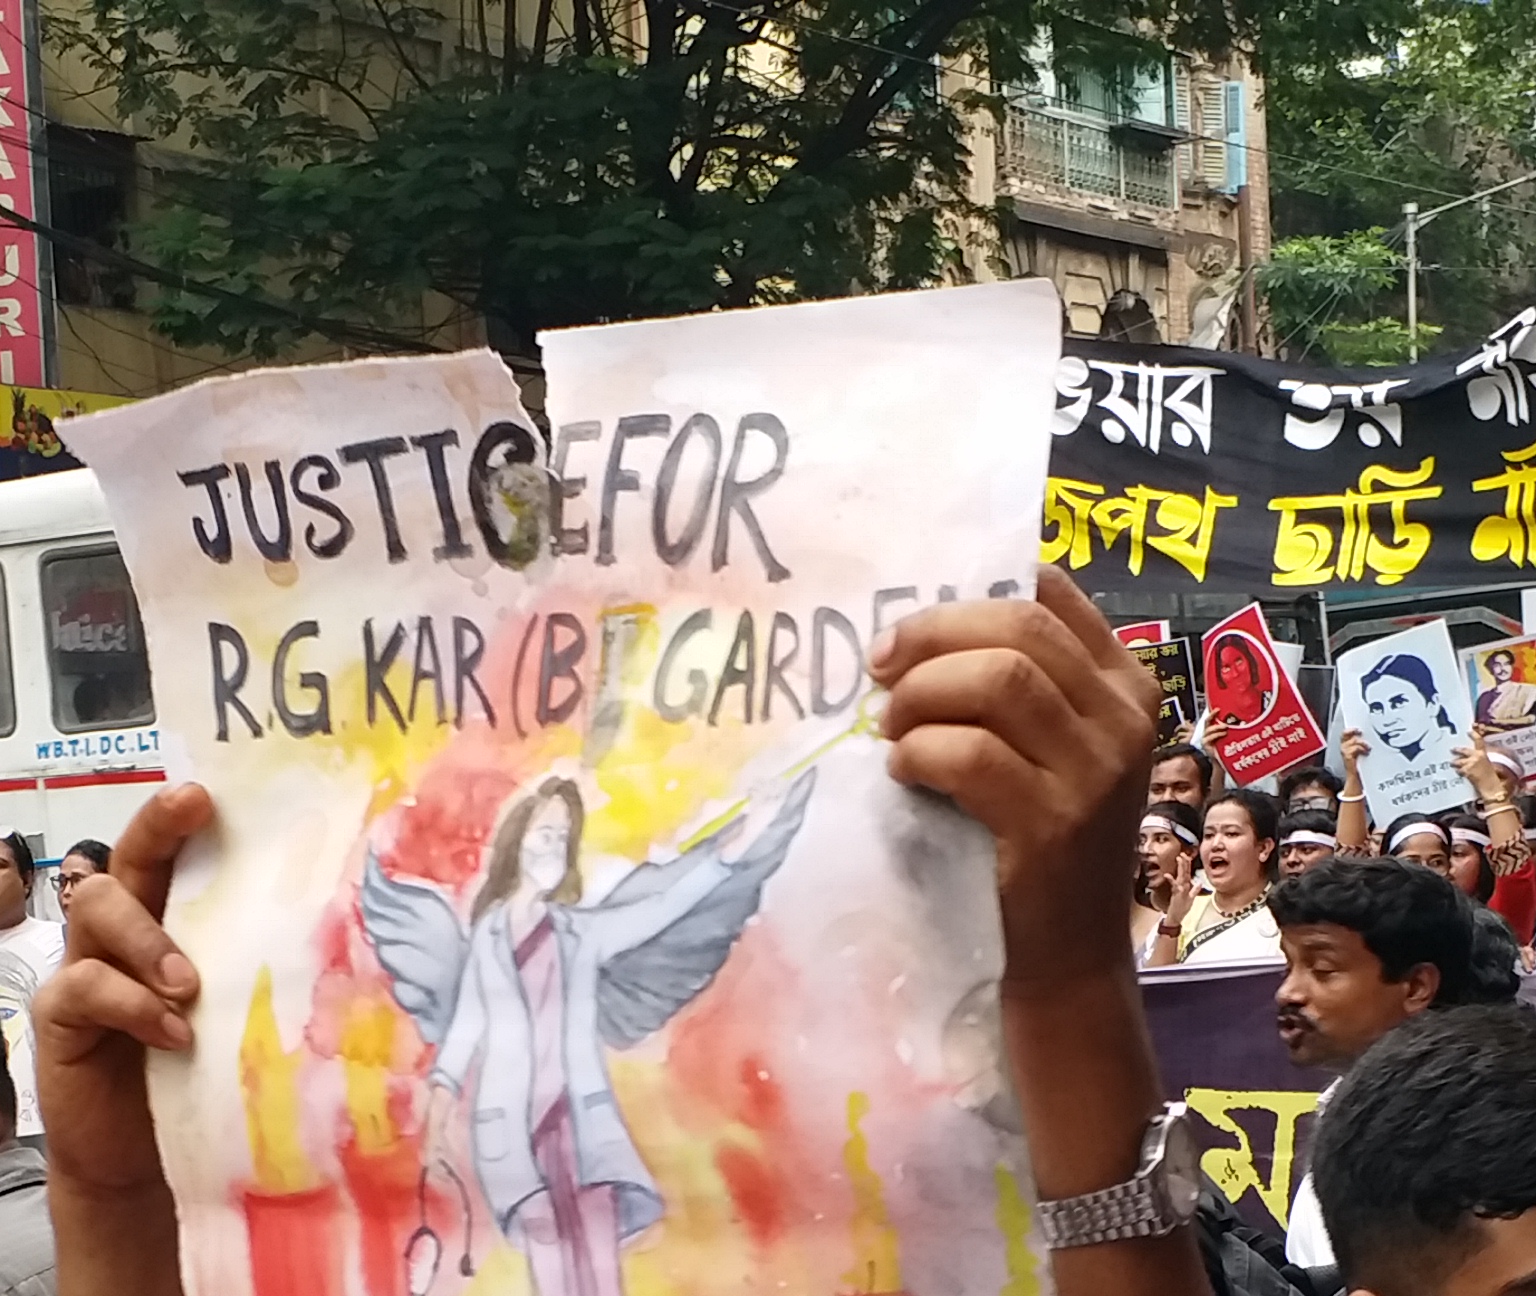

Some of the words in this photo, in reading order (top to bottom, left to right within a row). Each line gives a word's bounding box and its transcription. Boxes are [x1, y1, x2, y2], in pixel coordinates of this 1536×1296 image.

[1049, 356, 1227, 455] ভয়ার
[1038, 475, 1238, 584] জপথ
[363, 614, 498, 736] KAR
